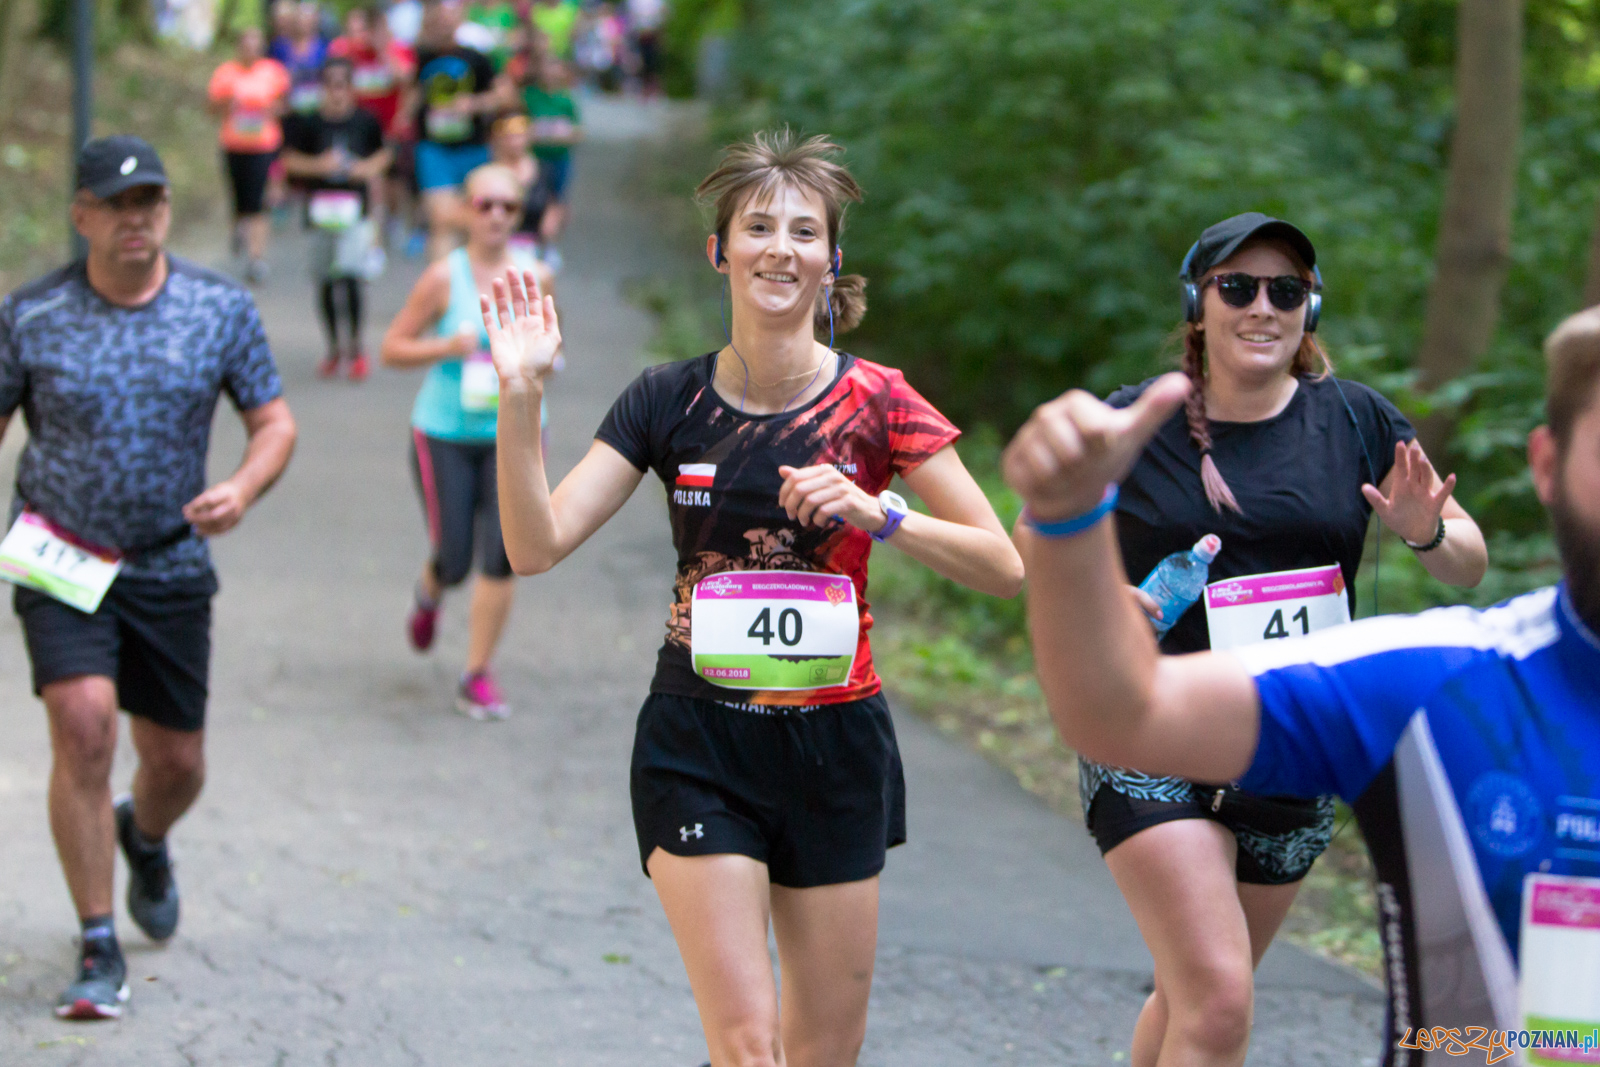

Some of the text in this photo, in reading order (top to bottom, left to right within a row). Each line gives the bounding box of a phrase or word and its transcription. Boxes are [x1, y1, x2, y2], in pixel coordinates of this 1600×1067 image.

[673, 490, 711, 506] POLSKA
[747, 607, 803, 646] 40
[1263, 605, 1310, 640] 41
[704, 669, 749, 678] 22.06.2018
[1556, 813, 1600, 843] POL
